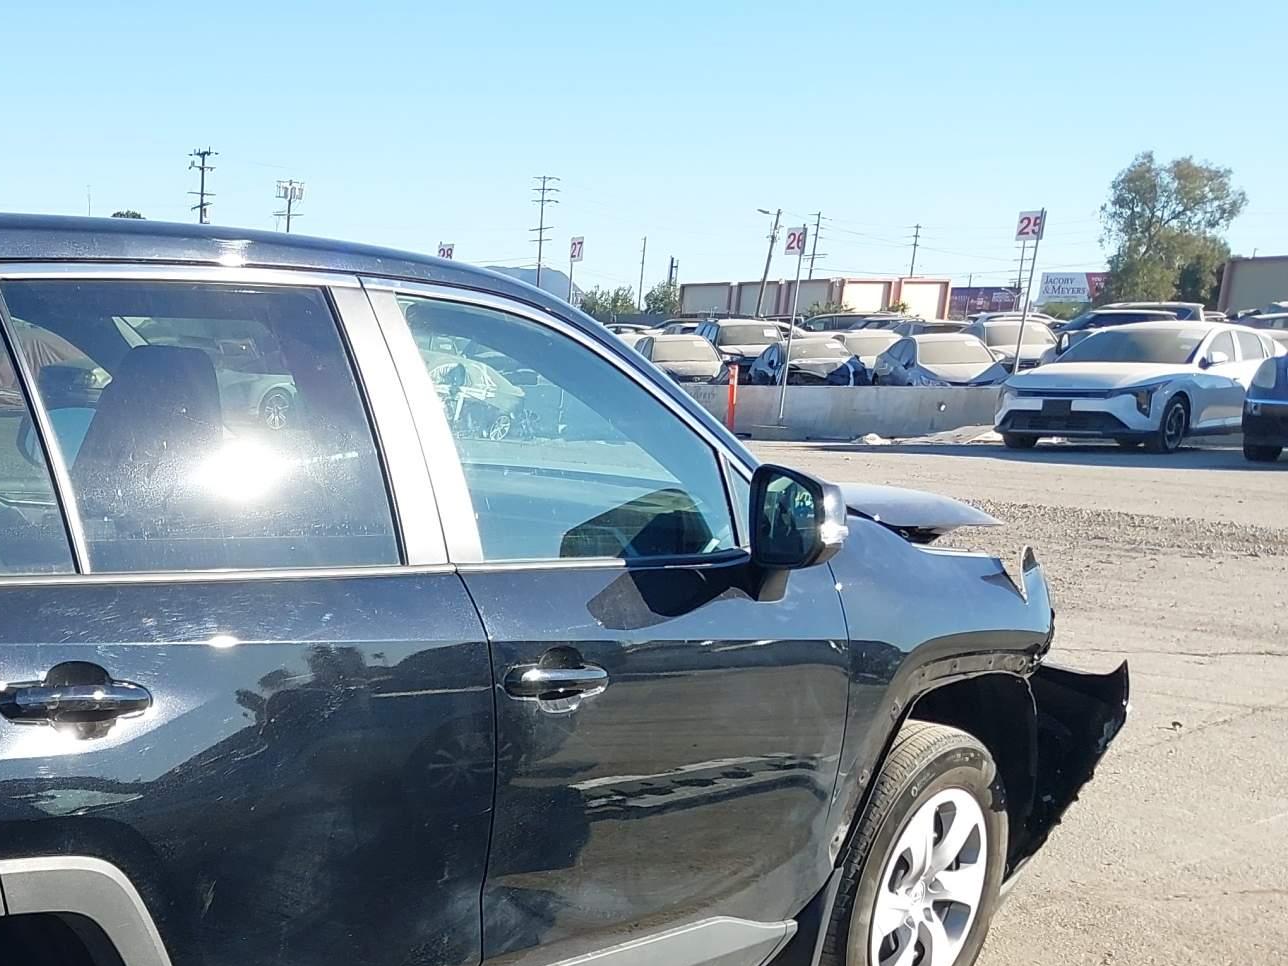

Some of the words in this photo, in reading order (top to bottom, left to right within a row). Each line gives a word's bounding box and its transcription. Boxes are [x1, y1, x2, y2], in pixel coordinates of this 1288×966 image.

[1016, 216, 1041, 236] 25
[570, 241, 584, 259] 27
[785, 231, 804, 251] 26
